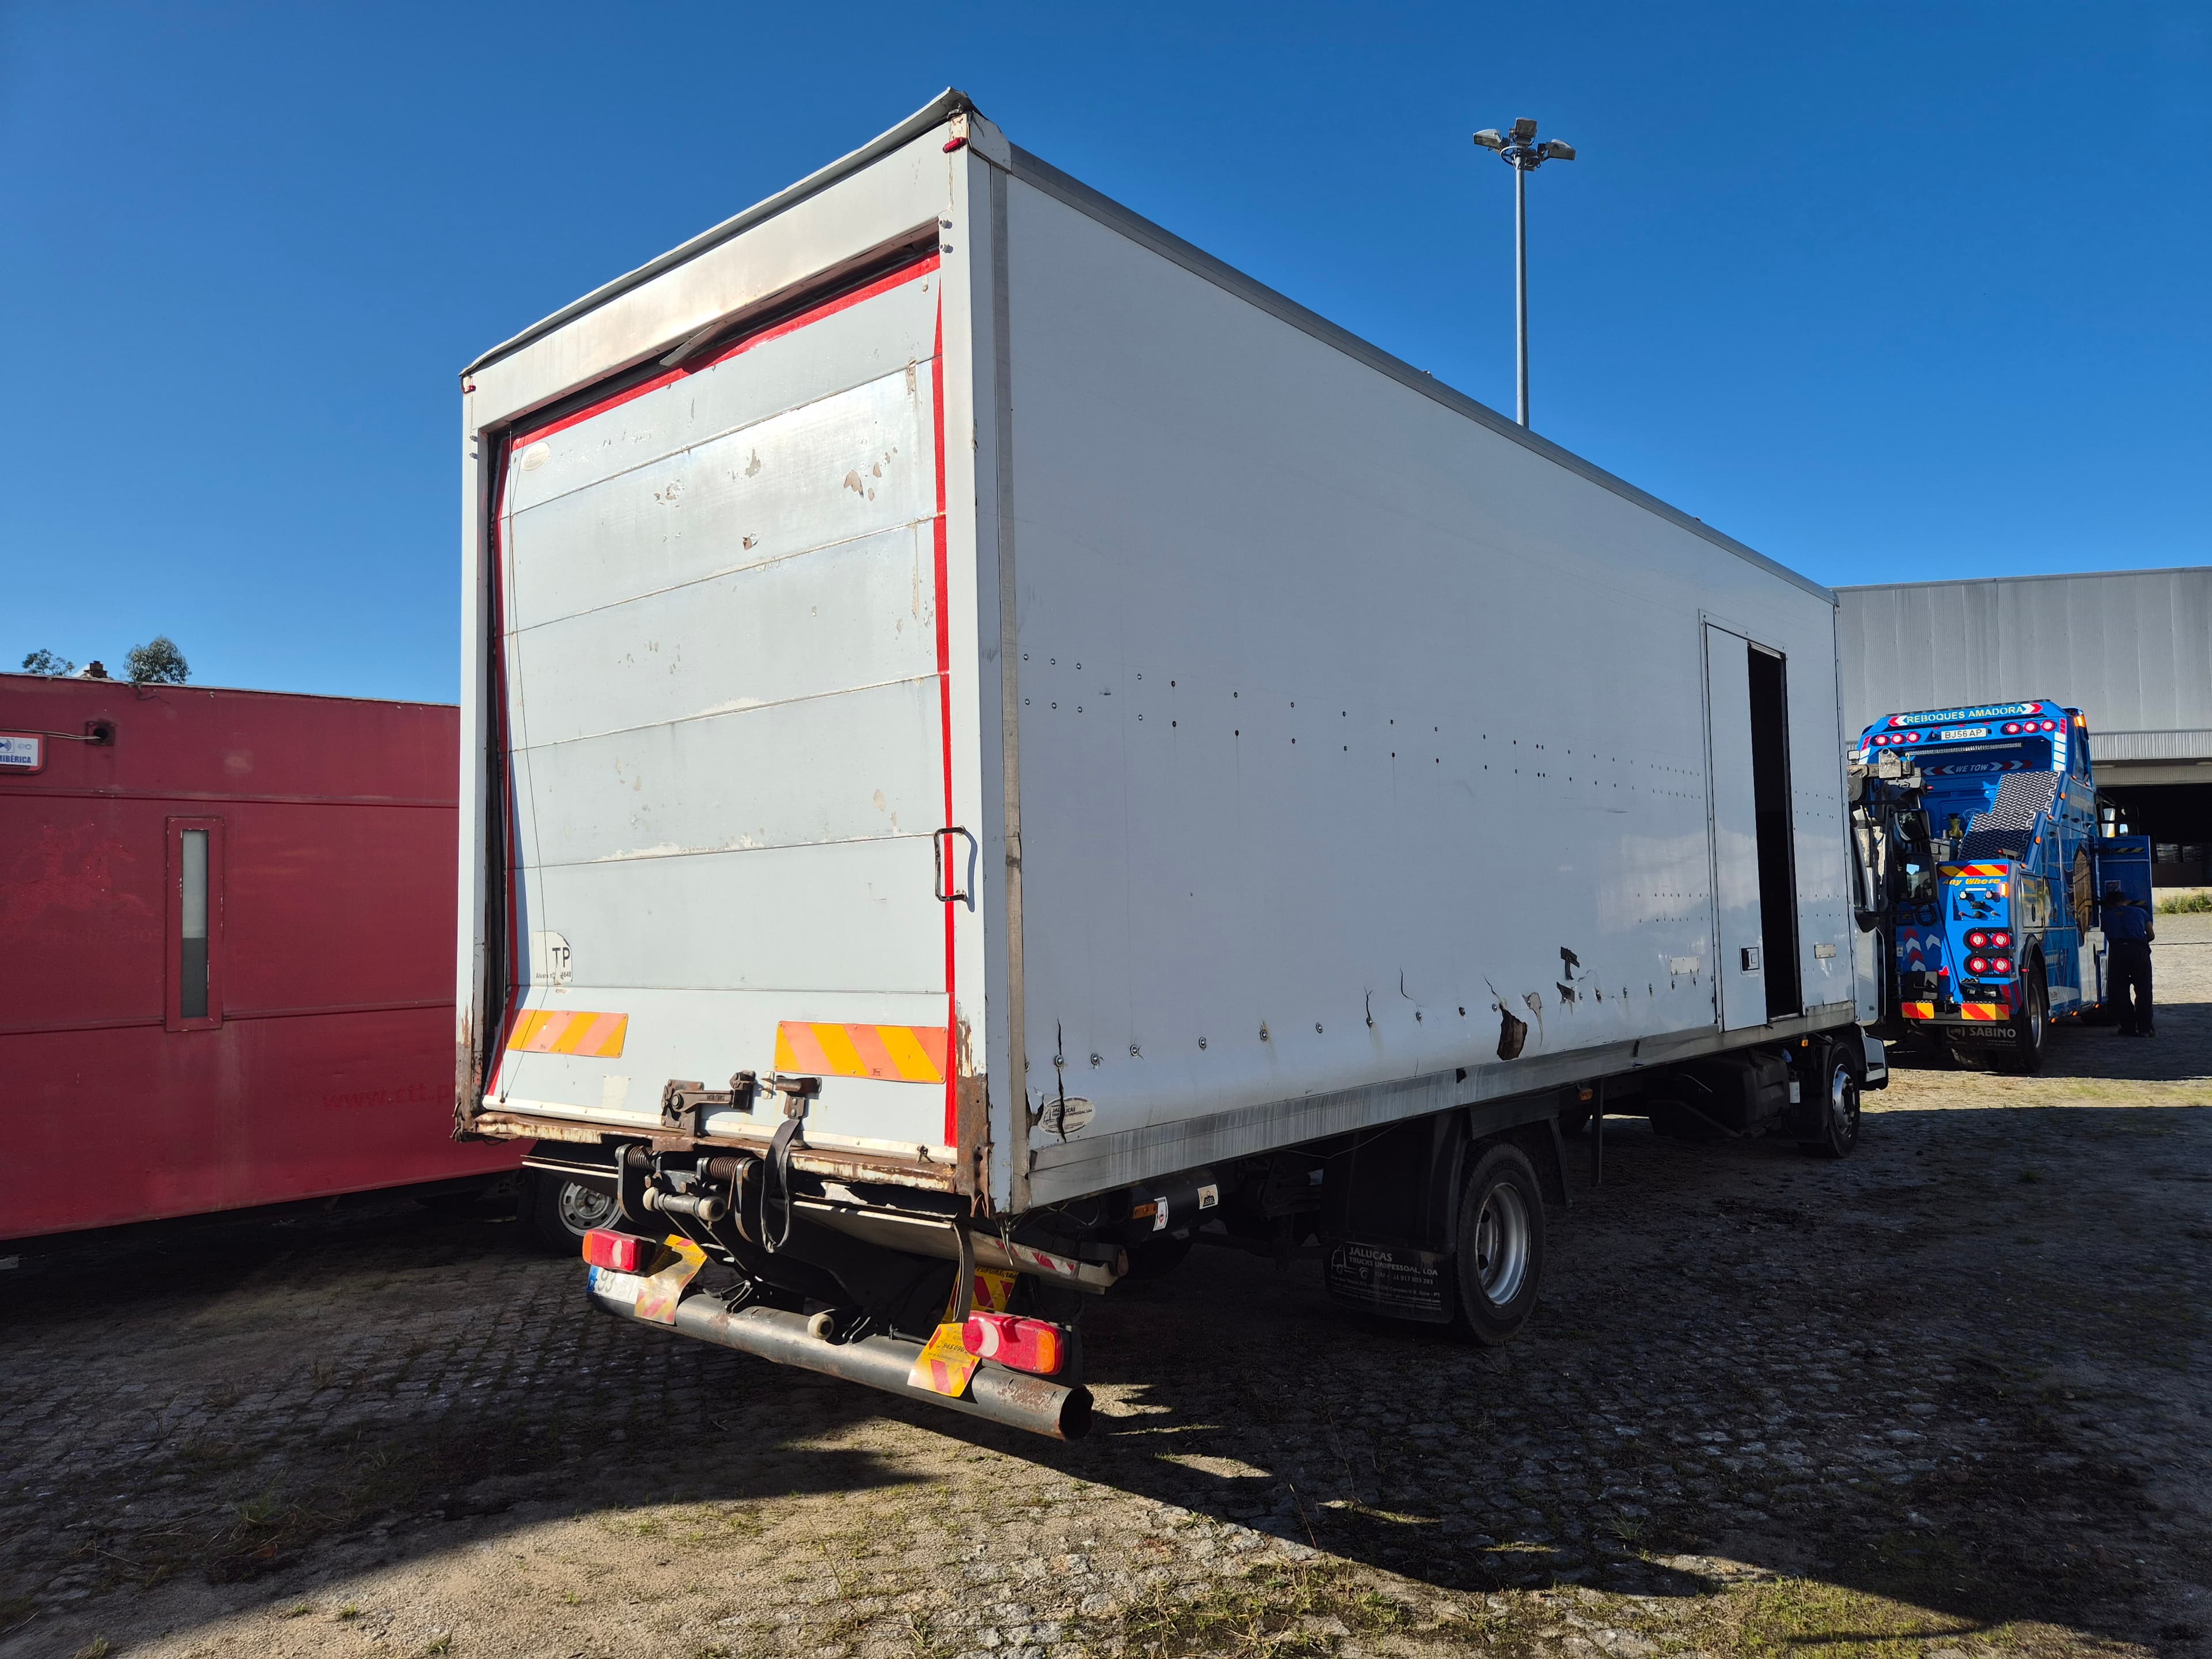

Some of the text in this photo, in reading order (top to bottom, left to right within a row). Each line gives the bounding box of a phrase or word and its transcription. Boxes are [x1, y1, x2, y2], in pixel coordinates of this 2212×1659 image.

[1907, 706, 2022, 724] REBOQUES AMADORA
[0, 754, 32, 764] IBÉRICA
[552, 947, 570, 968] TP
[1969, 1027, 2017, 1038] SABINO
[322, 1083, 459, 1111] www.ctt.p
[1349, 1247, 1392, 1262] JALUCAS
[1349, 1256, 1373, 1267] TRUCKS
[1423, 1268, 1438, 1277] LDA
